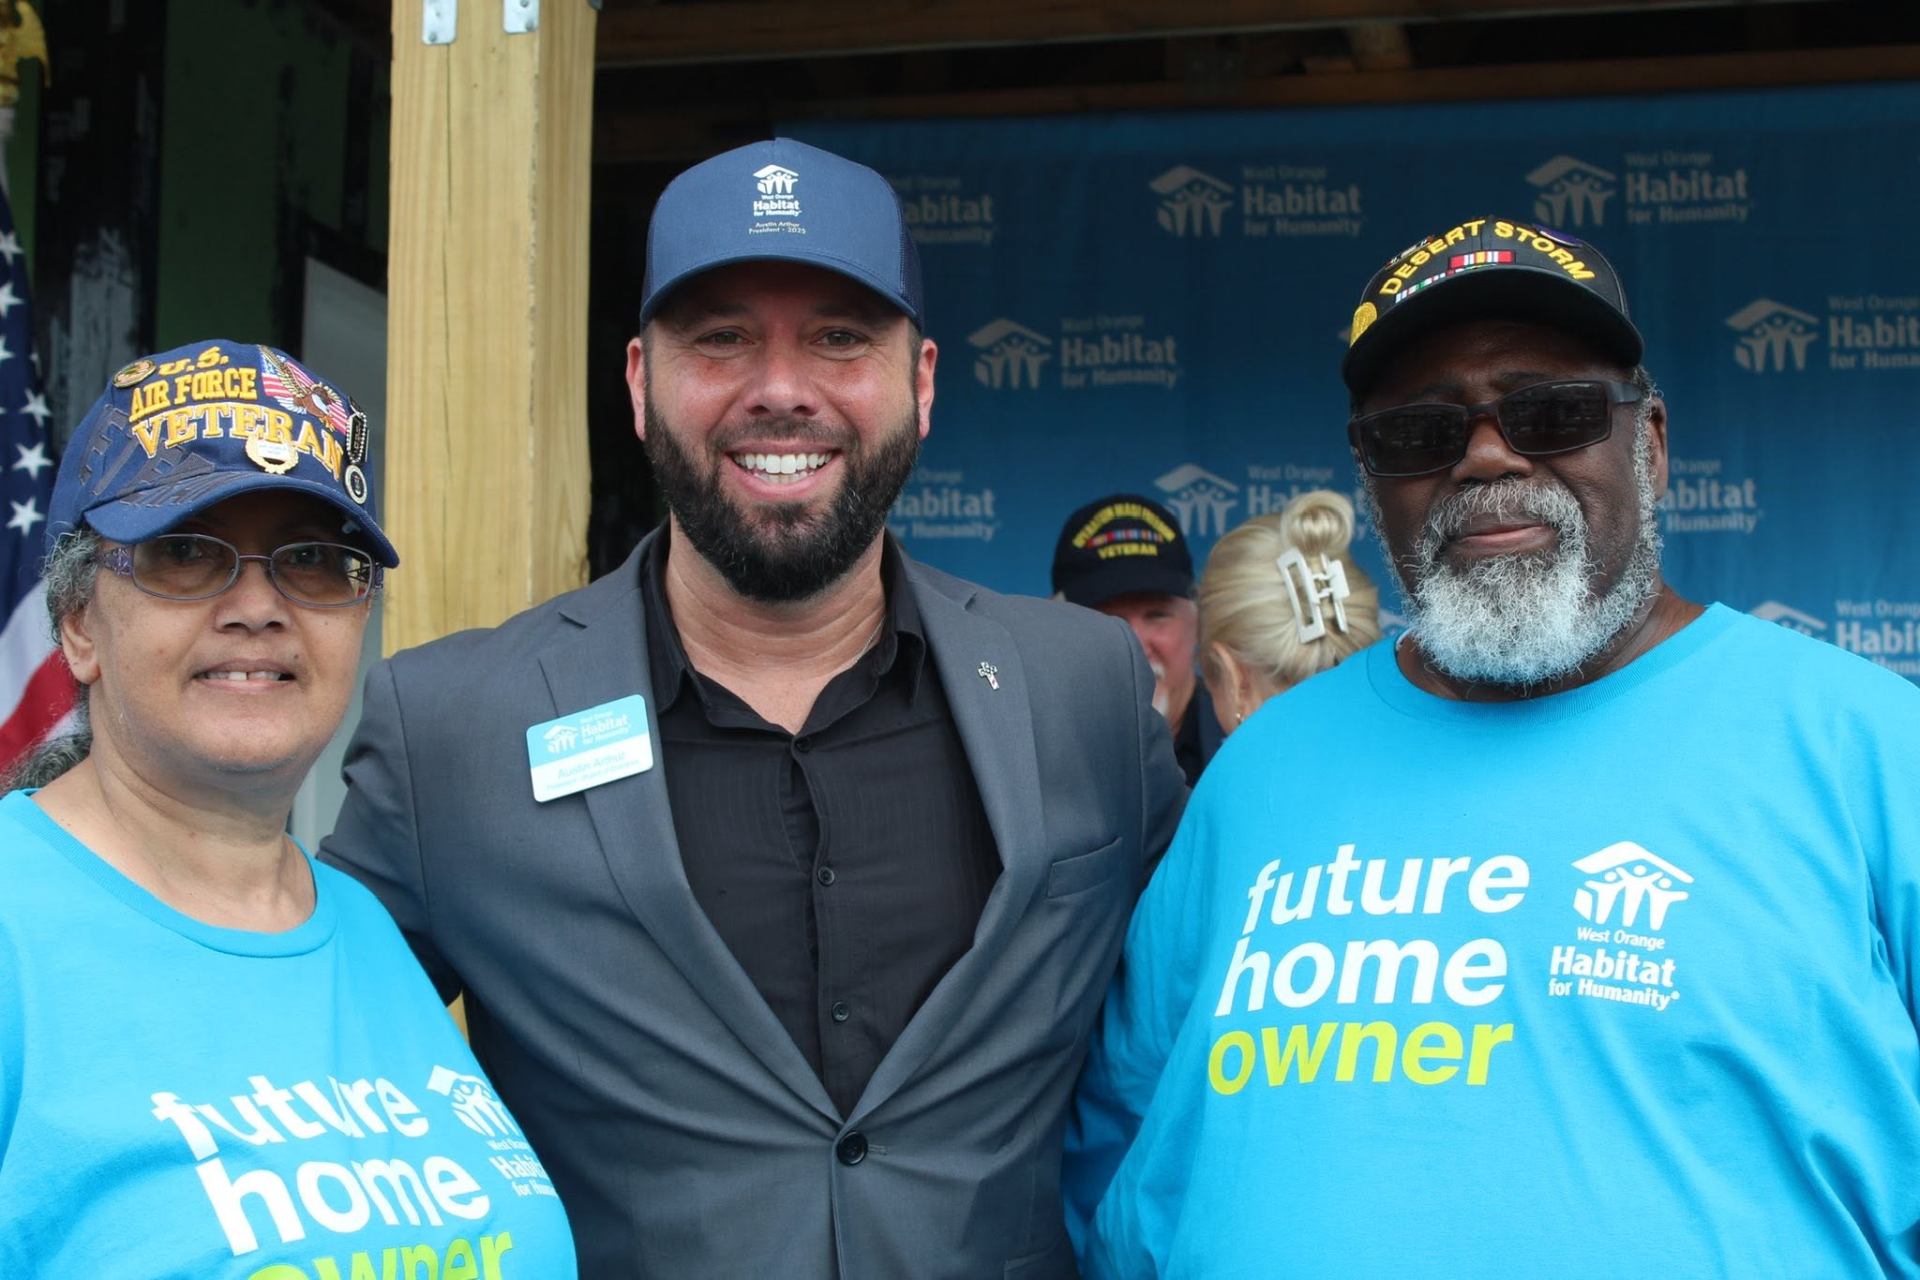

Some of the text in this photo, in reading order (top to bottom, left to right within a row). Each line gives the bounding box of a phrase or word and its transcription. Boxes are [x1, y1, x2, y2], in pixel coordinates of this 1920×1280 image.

[1242, 184, 1361, 214] Habitat
[1625, 169, 1748, 202] Habitat
[754, 200, 800, 211] Habitat
[903, 193, 993, 223] abitat
[1626, 207, 1652, 224] for
[1243, 219, 1267, 237] for
[1379, 218, 1597, 296] DESERT STORM
[1828, 315, 1920, 348] Habit
[157, 346, 229, 376] U.S.
[1061, 332, 1176, 368] Habitat
[1829, 351, 1857, 369] for
[129, 379, 170, 423] AIR
[173, 367, 258, 405] FORCE
[1061, 370, 1086, 388] for
[132, 401, 345, 482] VETERAN
[1656, 478, 1757, 509] abitat
[580, 713, 630, 738] Habitat
[1241, 844, 1530, 936] future
[1577, 926, 1666, 951] West Orange
[1214, 936, 1509, 1017] home
[1550, 945, 1677, 988] Habitat
[1548, 978, 1573, 996] for
[1207, 1020, 1514, 1096] owner
[150, 1075, 430, 1161] future
[195, 1155, 491, 1257] home
